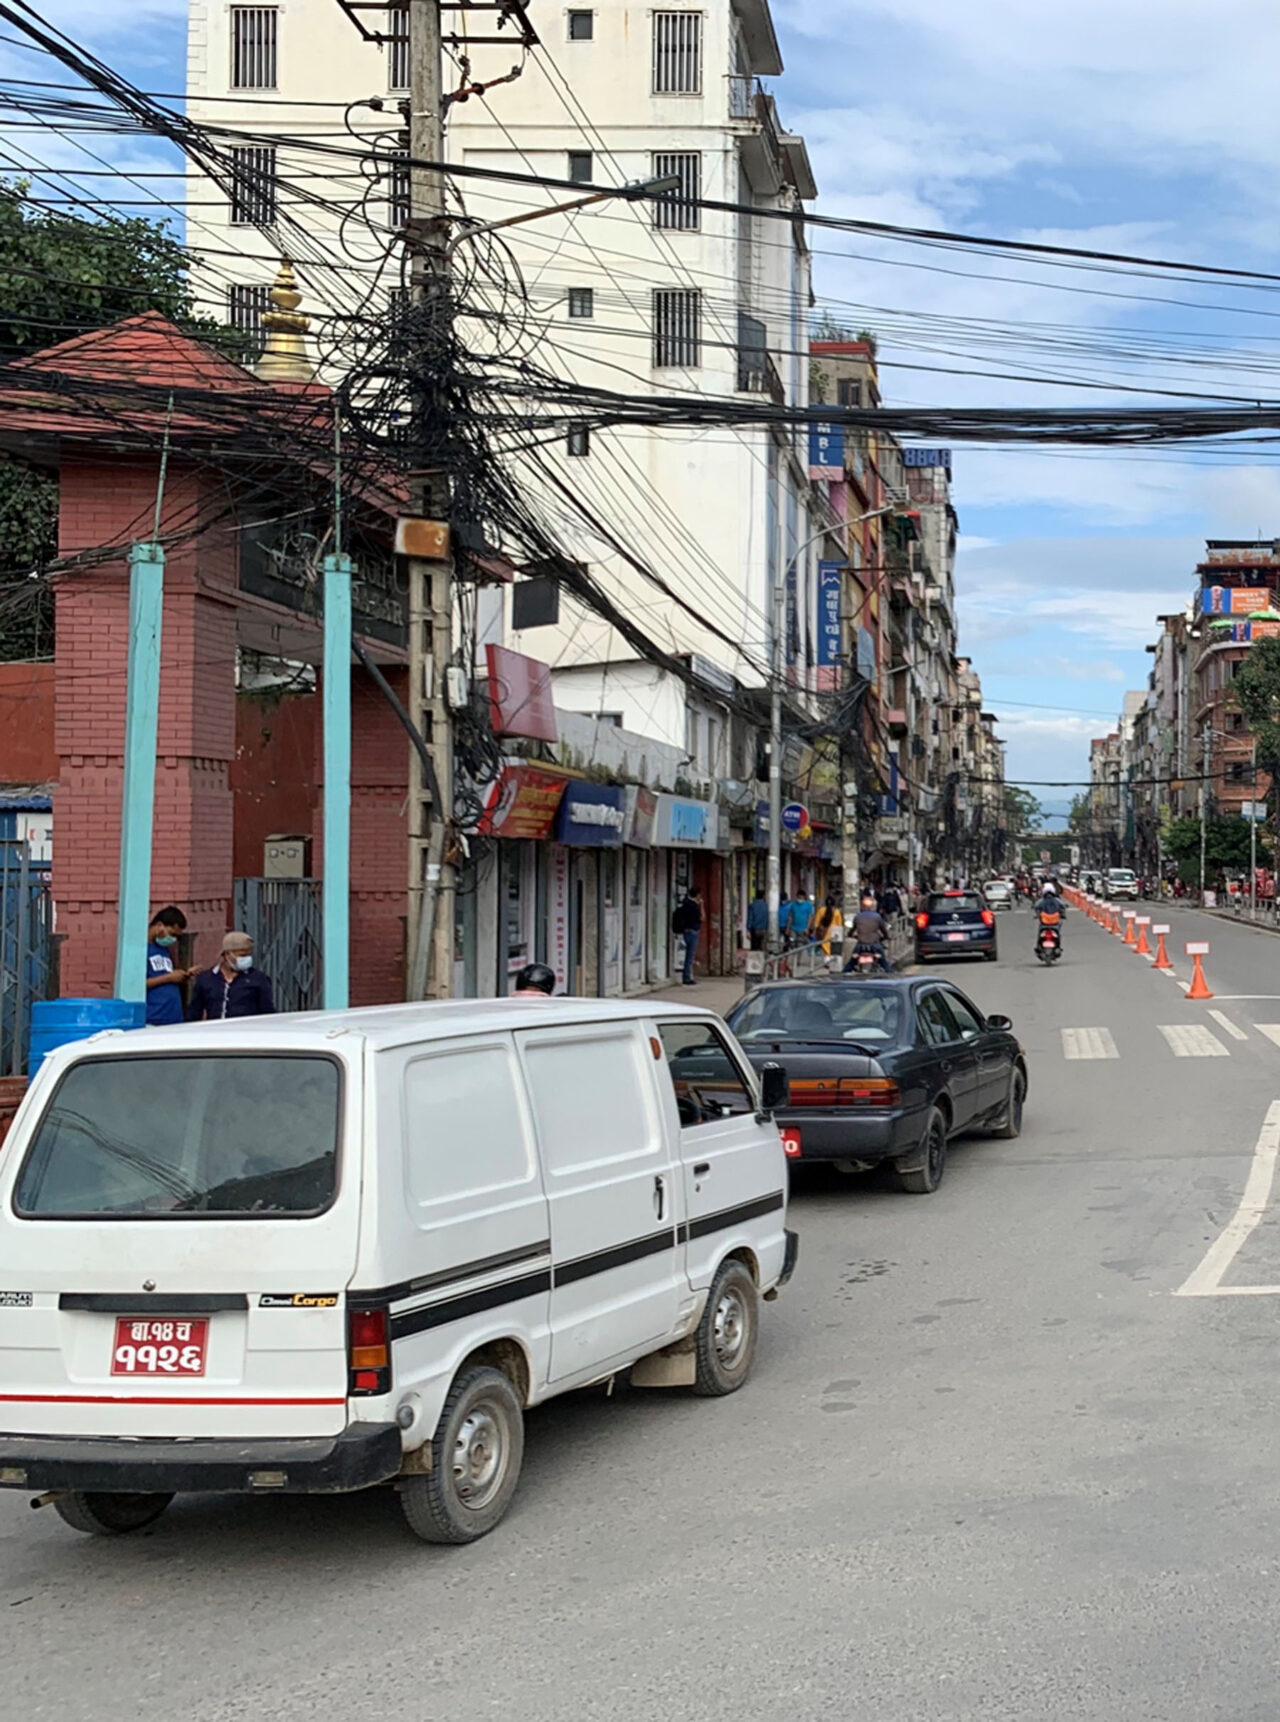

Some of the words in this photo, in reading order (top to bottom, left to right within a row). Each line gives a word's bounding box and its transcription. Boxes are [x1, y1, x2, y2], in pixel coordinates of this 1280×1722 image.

[904, 450, 951, 467] 8848
[261, 1296, 292, 1306] Omni
[293, 1294, 338, 1307] Cargo
[114, 1345, 202, 1371] ११२६
